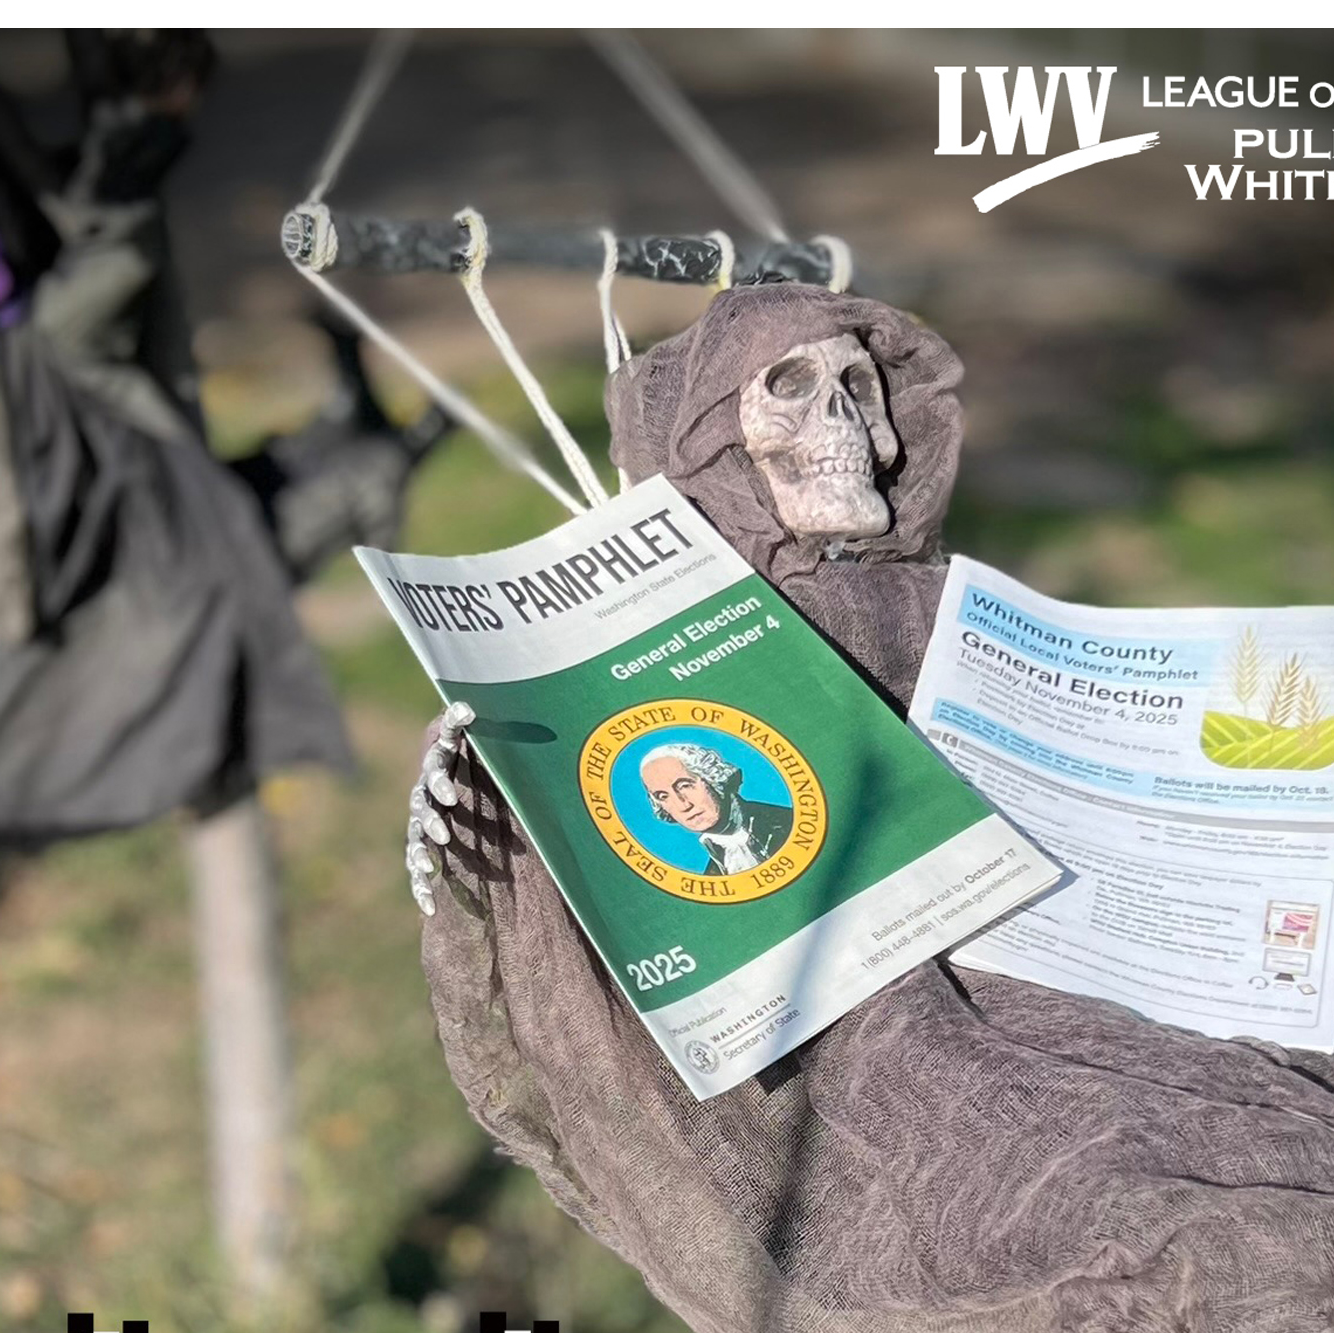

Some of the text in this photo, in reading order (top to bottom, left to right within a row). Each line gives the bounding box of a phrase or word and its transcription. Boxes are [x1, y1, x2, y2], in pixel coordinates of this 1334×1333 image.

[496, 509, 693, 624] PAMPHLET
[594, 553, 716, 620] Washington State Elections
[610, 596, 762, 681] General Election
[669, 615, 781, 682] November 4
[966, 611, 1199, 682] Official Local Voters' Pamphlet
[972, 592, 1174, 665] Whitman County
[958, 648, 1023, 687] Tuesday
[1025, 681, 1110, 716] November
[1114, 708, 1130, 721] 4,
[1135, 711, 1178, 726] 2025
[961, 630, 1061, 687] General
[1070, 678, 1184, 709] Election
[587, 707, 818, 897] THE SEAL OF THE STATE OF WASHINGTON 1889
[871, 916, 907, 942] Ballots
[906, 898, 937, 922] mailed
[937, 889, 953, 903] out
[952, 880, 967, 895] by
[964, 857, 1005, 885] October
[626, 945, 697, 991] 2025
[709, 994, 787, 1043] WASHINGTON
[723, 1030, 767, 1060] Secretary
[774, 1008, 801, 1028] State
